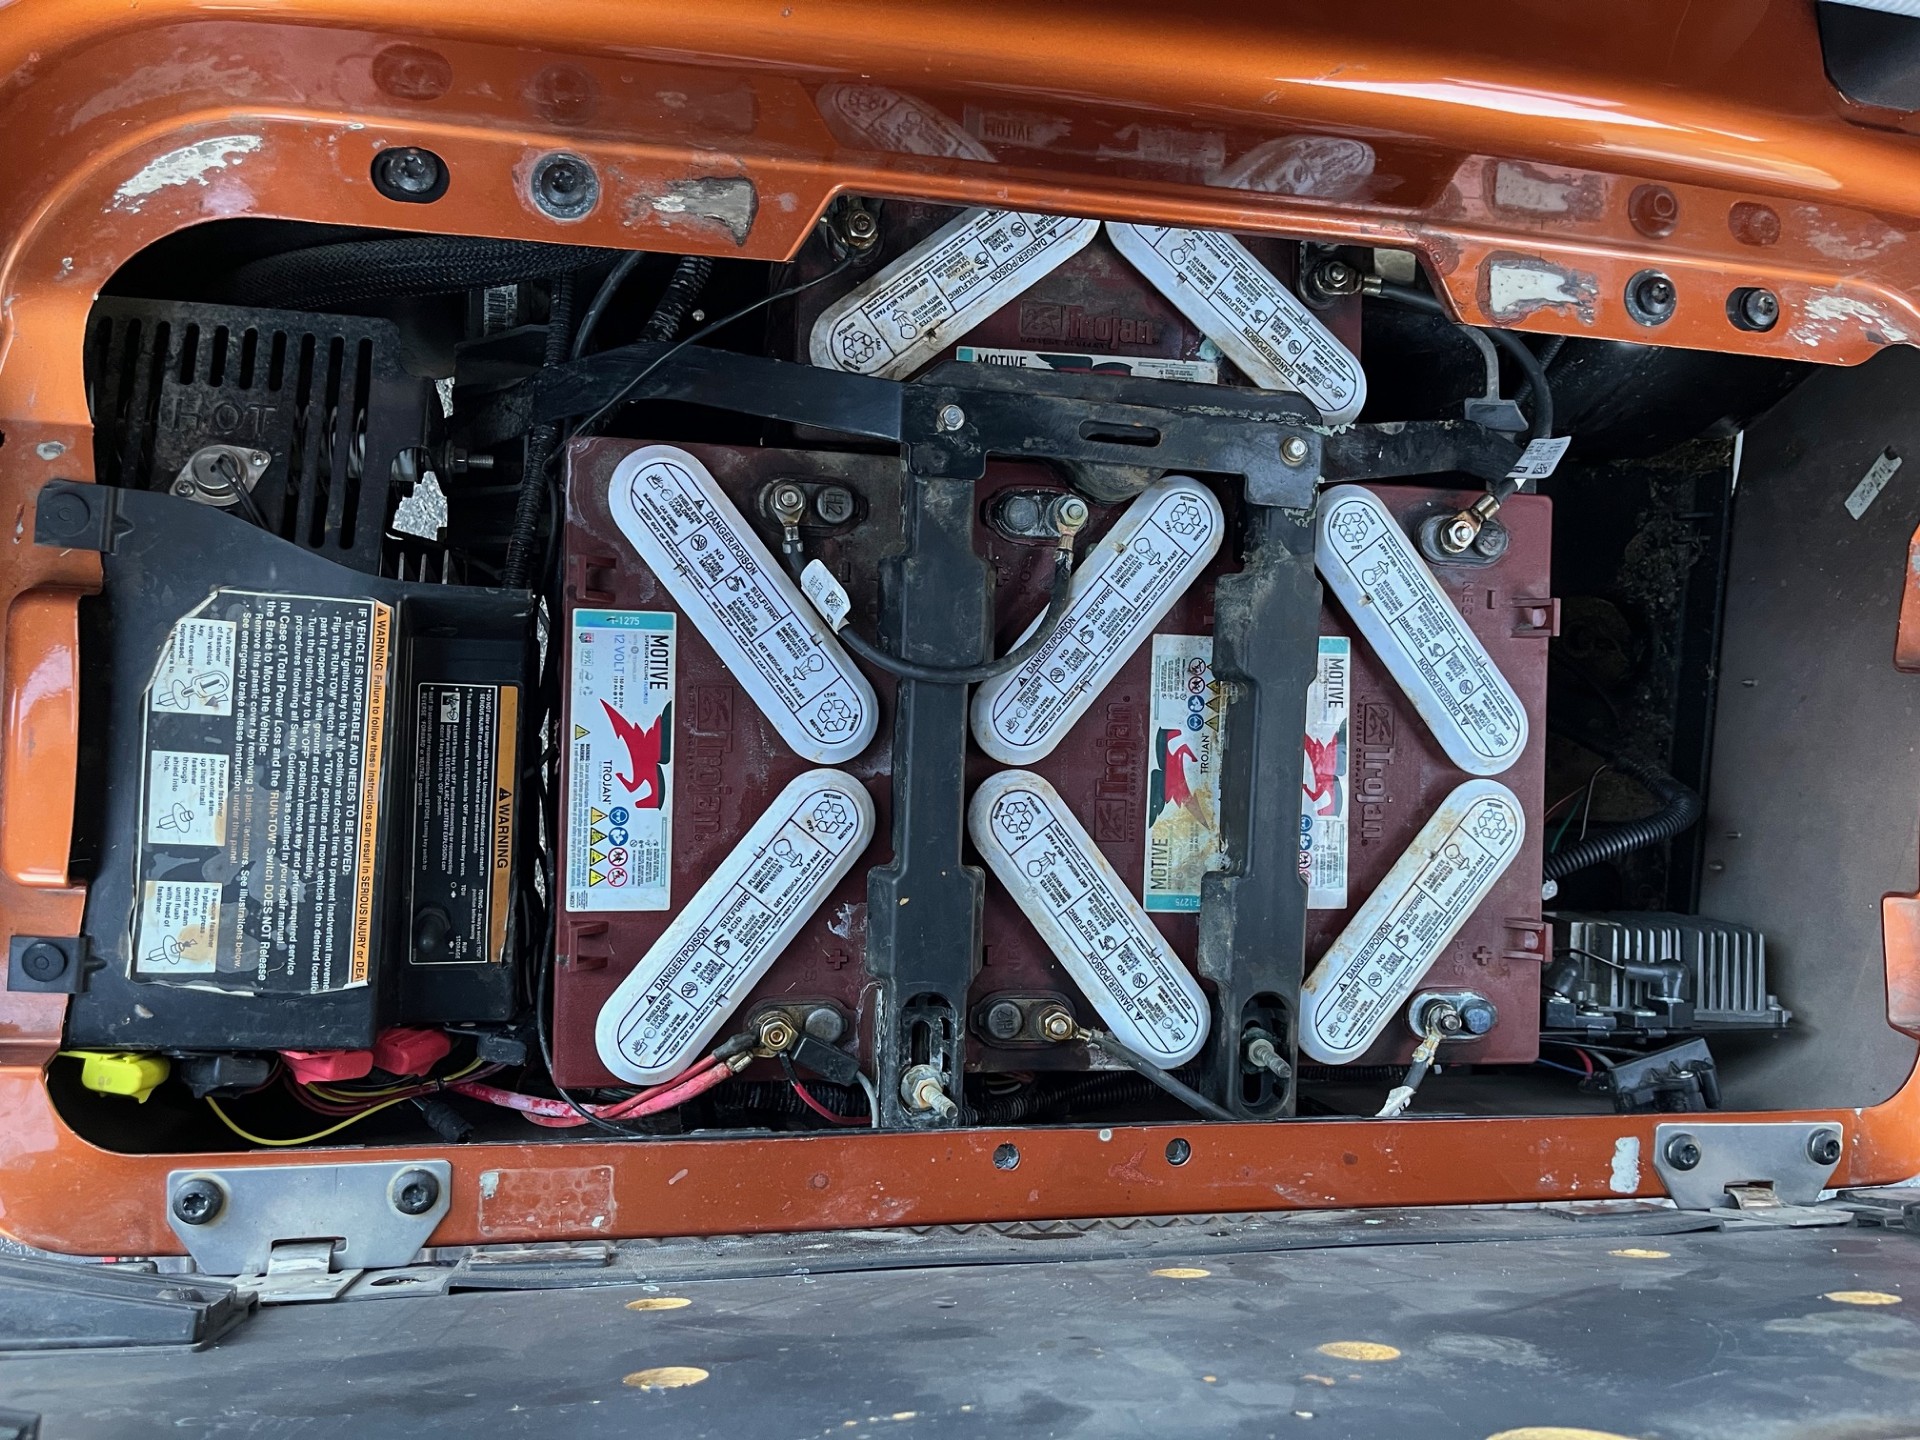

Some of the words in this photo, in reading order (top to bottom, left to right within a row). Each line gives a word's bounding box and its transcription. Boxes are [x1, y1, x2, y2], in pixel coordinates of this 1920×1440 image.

[987, 236, 1048, 283] DANGER/POISON
[1000, 241, 1014, 254] NO
[946, 273, 980, 300] SULFURIC
[957, 266, 975, 282] ACID
[1215, 286, 1246, 318] SULFURIC
[1233, 295, 1251, 312] ACID
[1241, 323, 1295, 380] DANGER/POISON
[1269, 333, 1282, 346] NO
[170, 395, 278, 437] HOT
[704, 509, 759, 577] DANGER/POISON
[712, 547, 725, 561] NO
[266, 600, 275, 616] the
[280, 601, 288, 613] IN
[357, 608, 366, 617] IF
[743, 590, 760, 610] ACID
[749, 585, 779, 622] SULFURIC
[1084, 586, 1113, 621] SULFURIC
[278, 615, 287, 641] Case
[1090, 607, 1106, 625] ACID
[264, 619, 274, 649] Brake
[343, 619, 352, 639] Turn
[355, 619, 365, 662] VEHICLE
[614, 633, 624, 643] 12
[784, 621, 799, 638] FLUSH
[1398, 614, 1425, 649] SULFURIC
[1415, 626, 1431, 644] ACID
[263, 652, 272, 662] to
[277, 643, 286, 654] of
[342, 641, 351, 655] the
[374, 619, 385, 670] WARNING
[1025, 614, 1077, 676] DANGER/POISON
[1058, 647, 1070, 660] NO
[275, 656, 285, 681] Total
[354, 664, 362, 674] IS
[613, 645, 624, 673] VOLT
[649, 634, 668, 690] MOTIVE
[756, 641, 768, 653] GET
[764, 651, 784, 675] MEDICAL
[781, 672, 794, 687] HELP
[262, 665, 271, 692] Move
[339, 657, 350, 691] ignition
[1327, 657, 1344, 708] MOTIVE
[1416, 656, 1462, 717] DANGER/POISON
[1444, 669, 1455, 682] NO
[273, 684, 283, 717] Power
[338, 693, 348, 709] key
[372, 674, 382, 703] Failure
[261, 695, 269, 712] the
[338, 710, 347, 720] to
[350, 676, 361, 741] INOPERABLE
[371, 706, 380, 714] to
[258, 714, 268, 755] Vehicle:
[272, 719, 281, 744] Loss
[337, 721, 346, 736] the
[369, 716, 379, 742] follow
[336, 738, 345, 749] 'N'
[348, 743, 357, 765] AND
[368, 744, 377, 767] these
[1095, 702, 1137, 797] Trojan
[1200, 734, 1209, 774] TROJAN
[180, 756, 188, 783] through
[200, 758, 205, 766] up
[208, 758, 216, 775] push
[219, 759, 225, 768] To
[270, 747, 280, 767] and
[334, 751, 344, 787] position
[269, 769, 278, 786] the
[346, 767, 356, 801] NEEDS
[602, 760, 612, 802] TROJAN
[333, 789, 342, 806] and
[364, 770, 376, 819] instructions
[1355, 747, 1394, 838] Trojan
[266, 789, 277, 844] 'RUN-TOW'
[331, 807, 341, 834] chock
[345, 804, 353, 817] TO
[344, 819, 352, 833] BE
[363, 822, 372, 837] can
[496, 804, 510, 868] WARNING
[329, 836, 339, 855] tires
[342, 836, 351, 874] MOVED:
[362, 839, 371, 863] result
[263, 847, 273, 880] Switch
[329, 857, 337, 866] to
[361, 865, 370, 873] in
[1150, 838, 1168, 889] MOTIVE
[327, 868, 337, 901] prevent
[359, 875, 369, 915] SERIOUS
[261, 884, 271, 914] DOES
[719, 891, 752, 930] SULFURIC
[1399, 892, 1426, 926] SULFURIC
[260, 916, 269, 938] NOT
[324, 903, 335, 951] inadvertent
[356, 916, 366, 948] INJURY
[725, 915, 743, 935] ACID
[1067, 907, 1095, 941] SULFURIC
[1085, 918, 1101, 937] ACID
[1404, 912, 1420, 930] ACID
[257, 941, 268, 980] Release
[356, 950, 364, 959] or
[653, 923, 710, 992] DANGER/POISON
[1345, 920, 1393, 980] DANGER/POISON
[1374, 952, 1386, 965] NO
[354, 961, 364, 981] DEA
[690, 960, 703, 974] NO
[1115, 963, 1127, 976] NO
[1086, 950, 1135, 1012] DANGER/POISON
